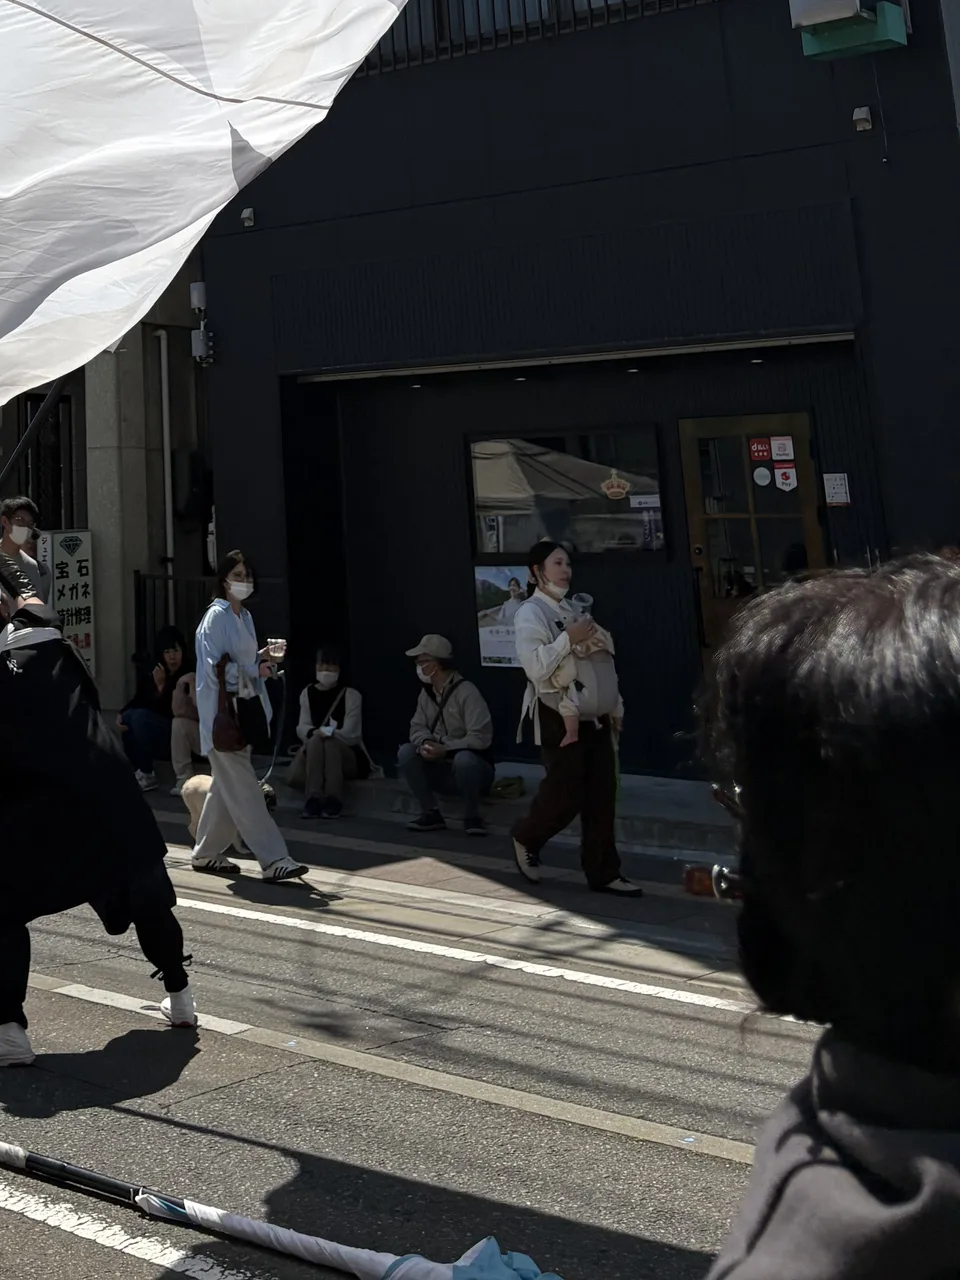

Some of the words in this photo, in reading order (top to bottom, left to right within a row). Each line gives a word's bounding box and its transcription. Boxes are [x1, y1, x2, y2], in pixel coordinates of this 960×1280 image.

[55, 559, 89, 580] 宝石
[57, 582, 91, 601] メガネ
